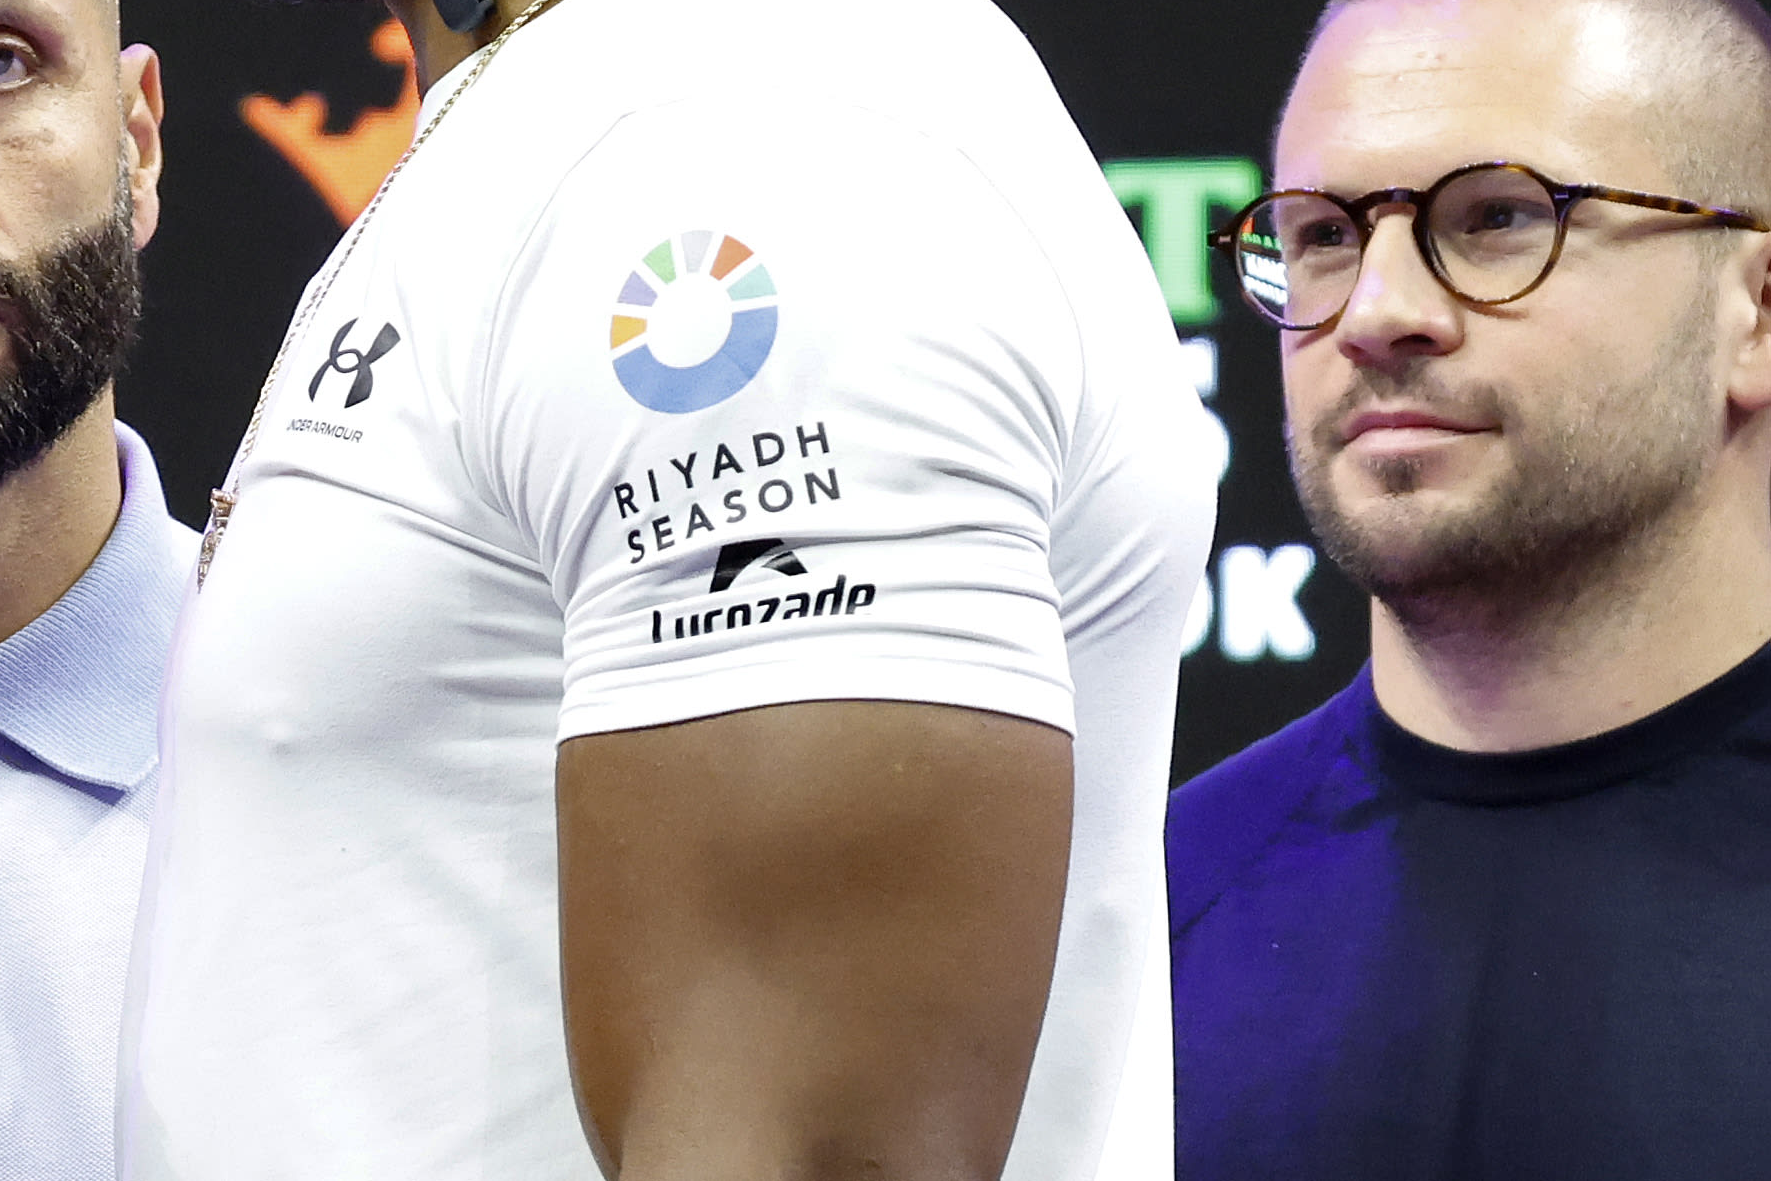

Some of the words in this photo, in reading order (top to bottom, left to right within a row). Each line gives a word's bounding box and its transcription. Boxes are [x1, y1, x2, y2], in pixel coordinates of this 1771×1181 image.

[311, 421, 363, 443] ARMOUR
[612, 421, 830, 519] RIYADH
[627, 467, 840, 564] SEASON
